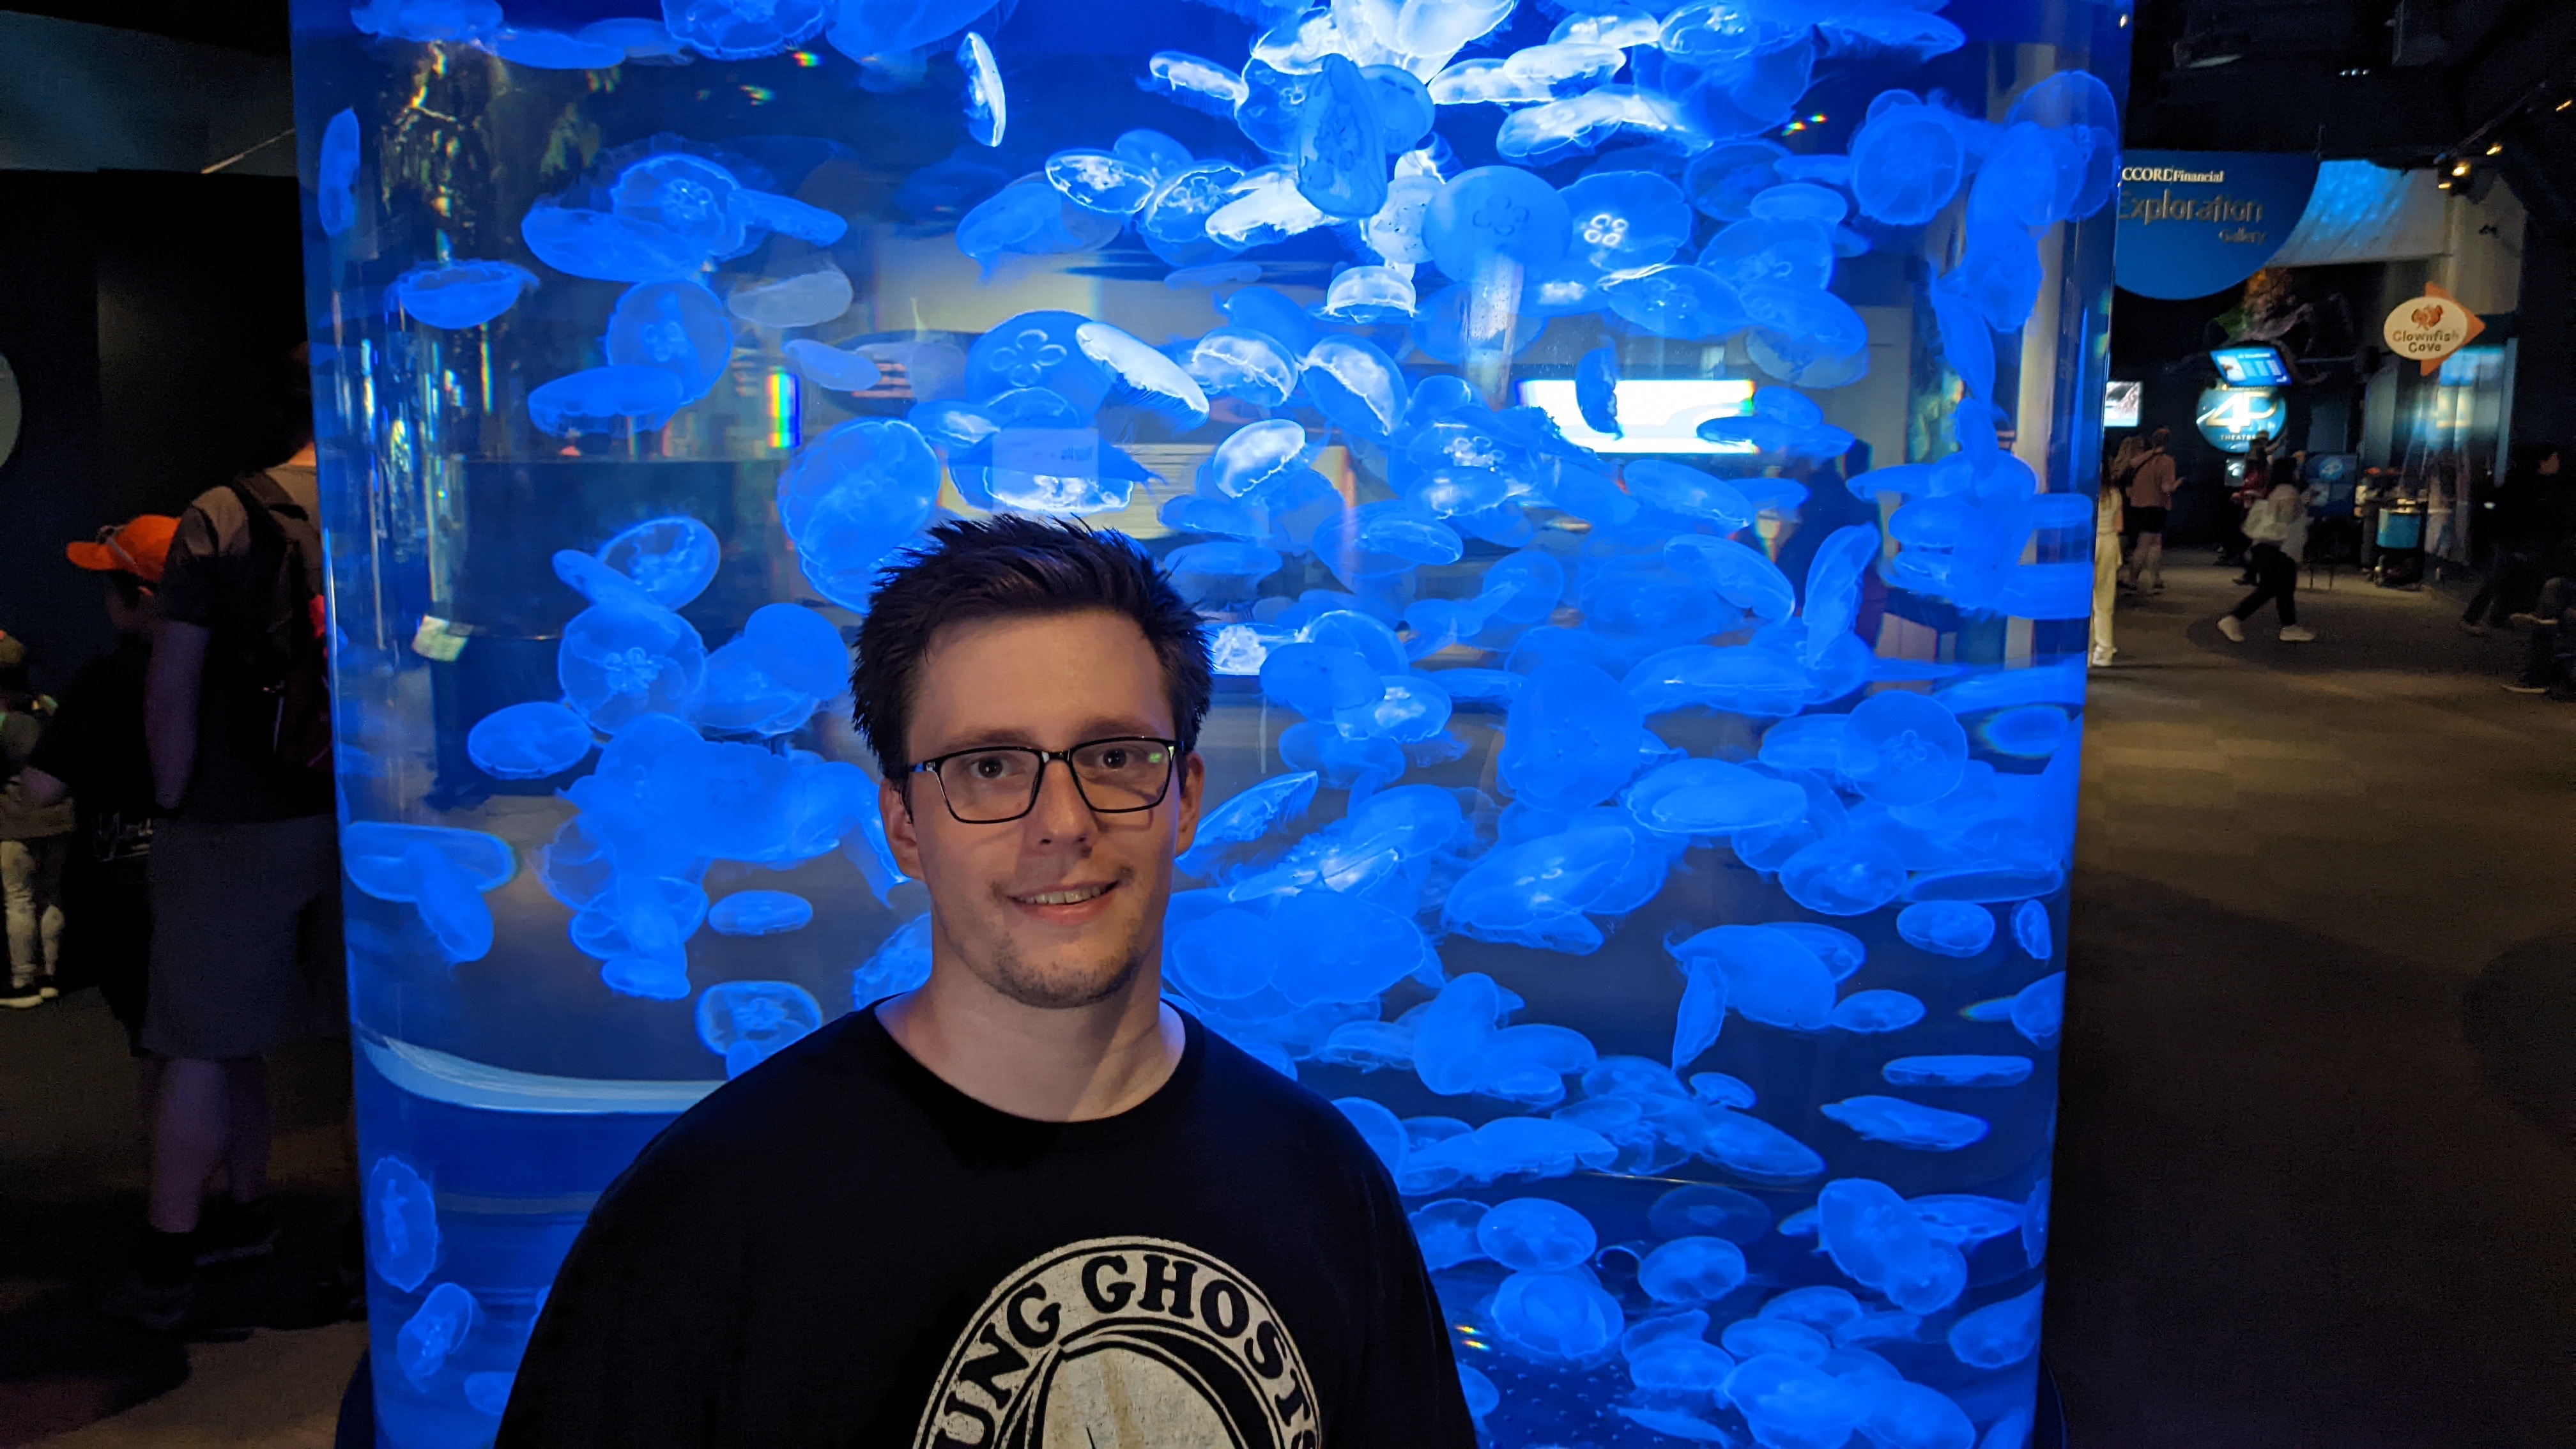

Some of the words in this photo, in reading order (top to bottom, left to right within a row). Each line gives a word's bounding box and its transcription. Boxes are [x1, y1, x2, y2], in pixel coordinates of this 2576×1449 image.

[2174, 169, 2225, 183] Financial
[2119, 188, 2264, 226] Exploration
[2218, 226, 2268, 246] Gallery
[2392, 329, 2460, 343] Clownfish
[2408, 342, 2442, 353] Cove
